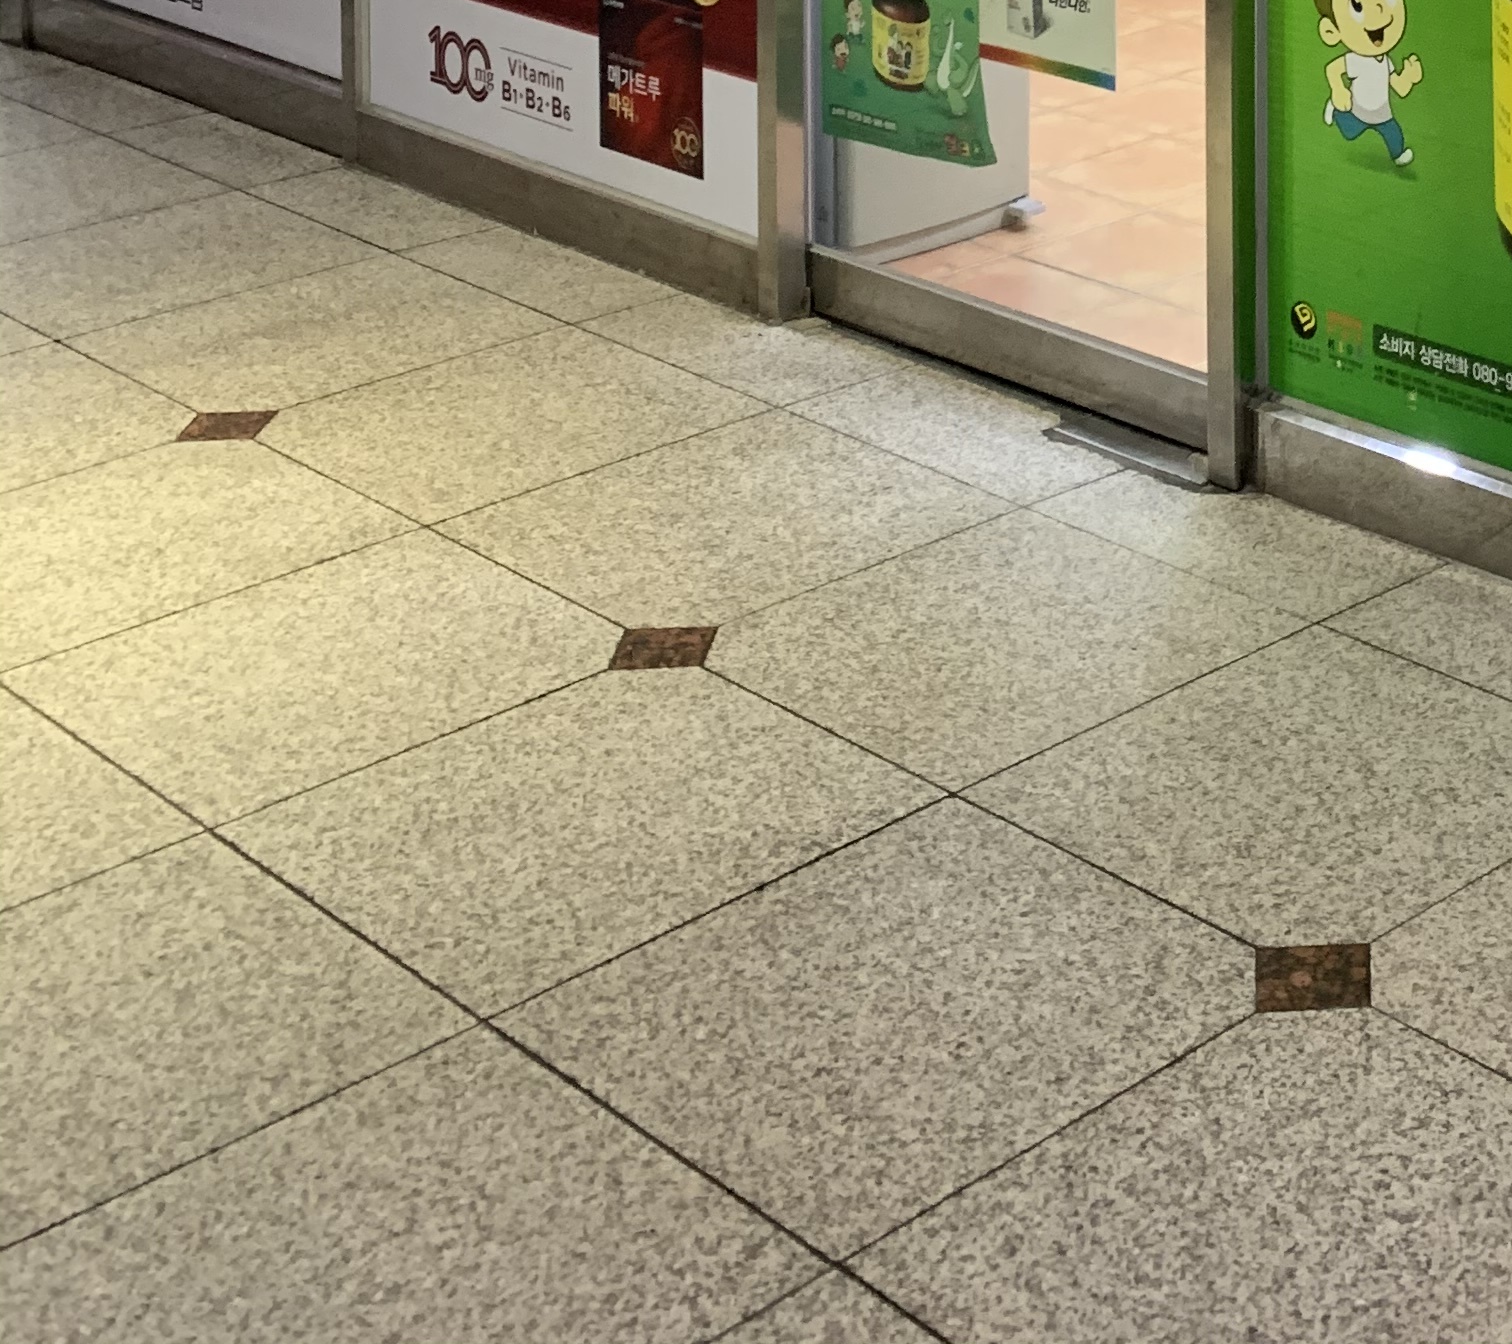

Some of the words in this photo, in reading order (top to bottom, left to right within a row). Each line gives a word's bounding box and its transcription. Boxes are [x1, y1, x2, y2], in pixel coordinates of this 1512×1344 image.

[507, 56, 565, 92] Vitamin
[607, 64, 662, 102] 메가트루
[607, 91, 636, 122] 파워
[1379, 332, 1416, 361] 소비자
[1418, 346, 1469, 378] 상담전화
